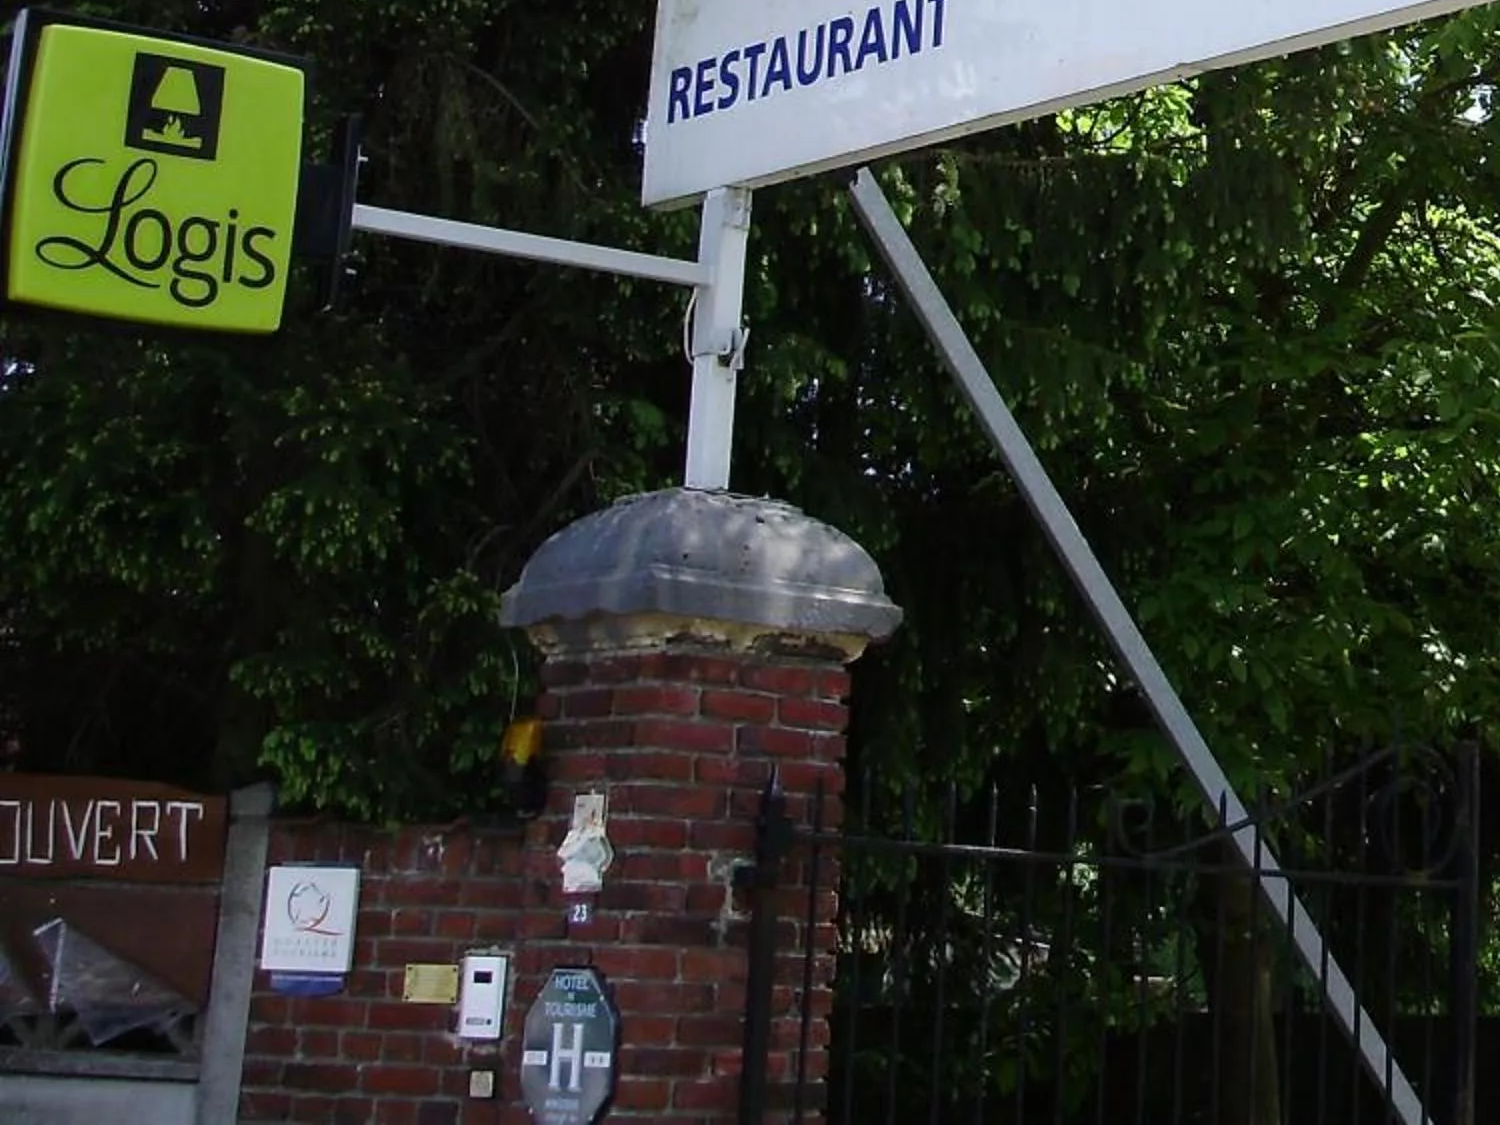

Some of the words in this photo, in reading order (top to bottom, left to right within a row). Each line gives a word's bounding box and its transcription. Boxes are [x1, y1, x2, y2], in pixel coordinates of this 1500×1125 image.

[35, 158, 277, 307] Logis
[0, 800, 204, 865] OUVERT
[548, 1022, 585, 1092] H
